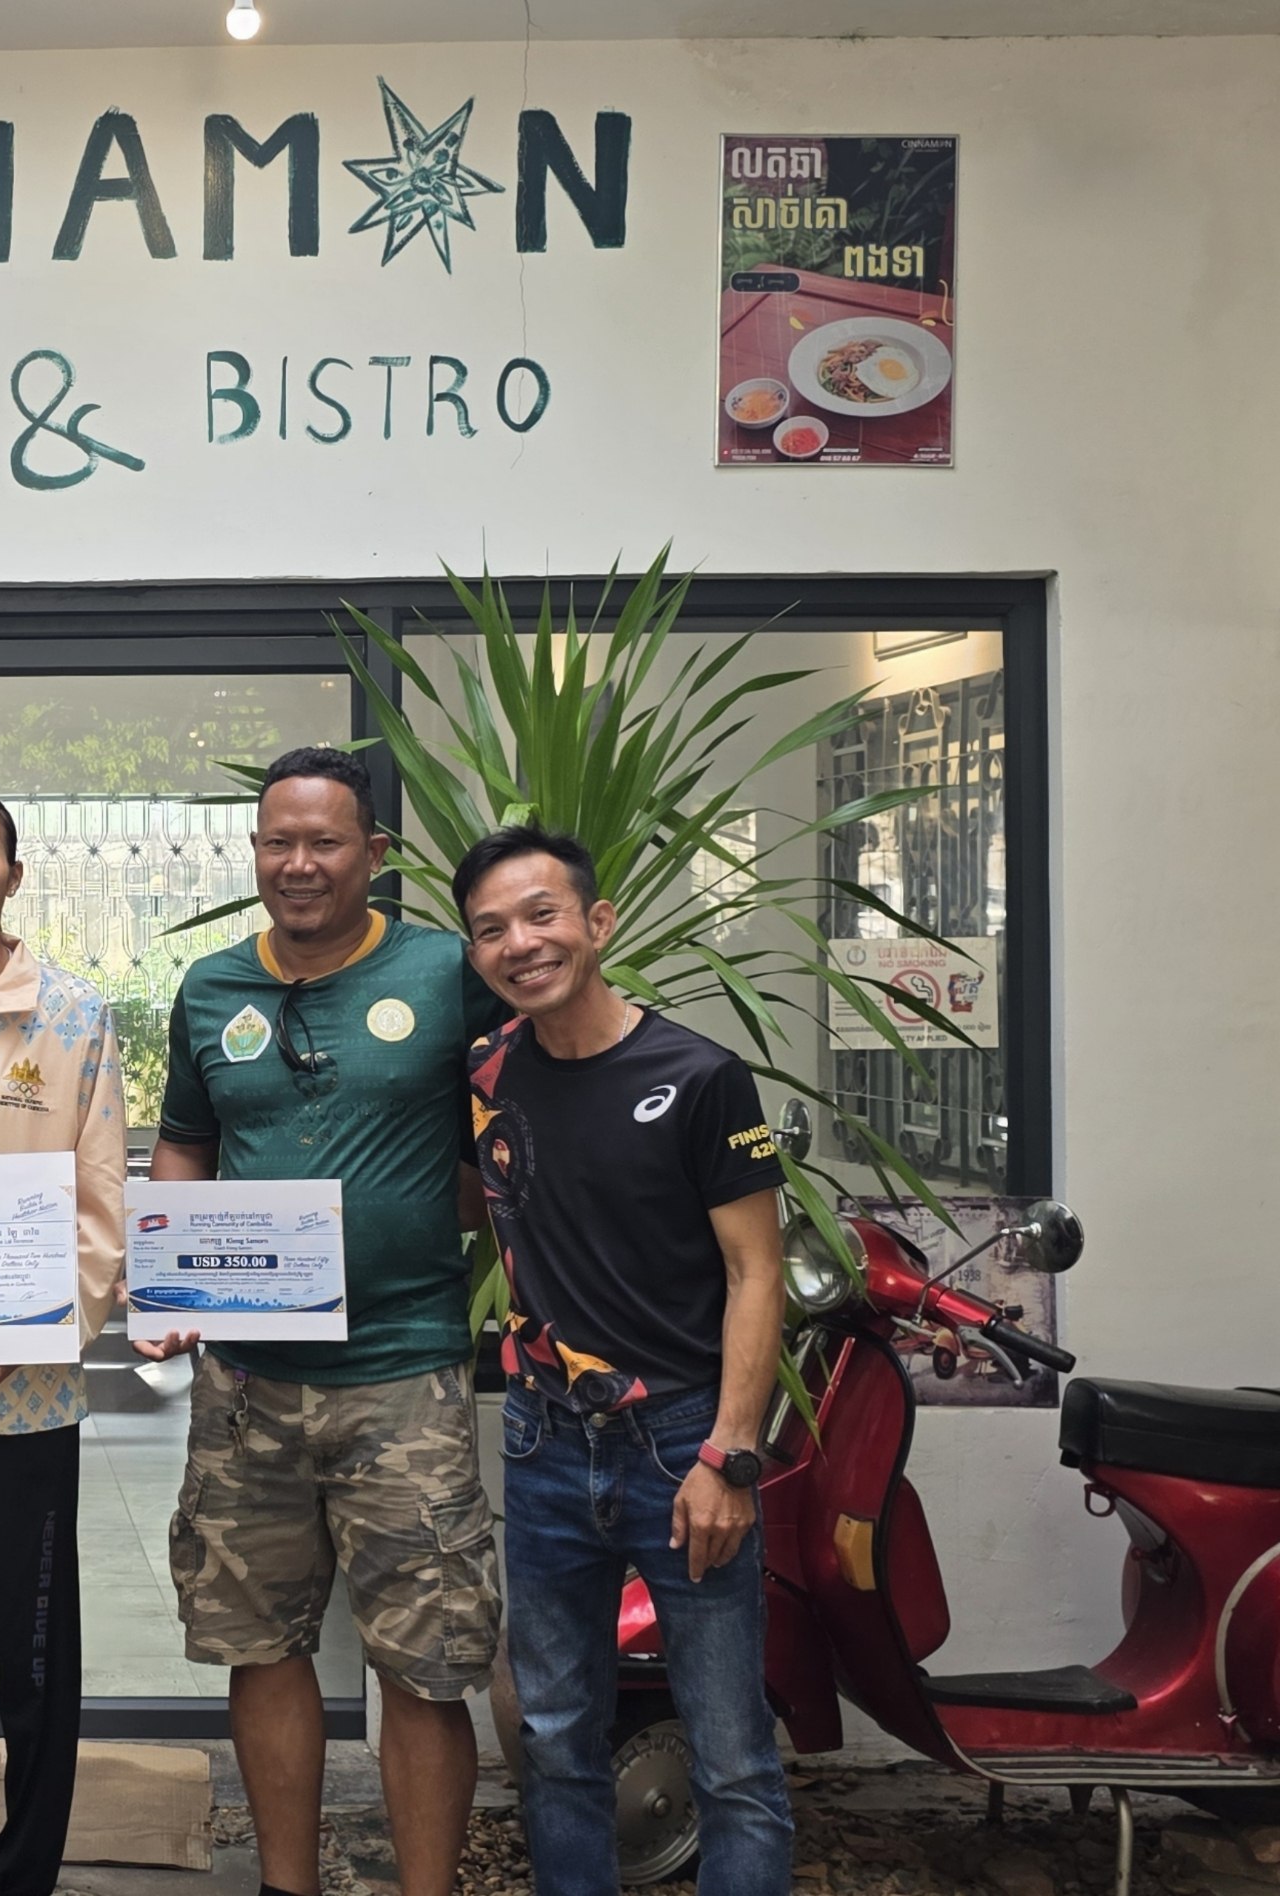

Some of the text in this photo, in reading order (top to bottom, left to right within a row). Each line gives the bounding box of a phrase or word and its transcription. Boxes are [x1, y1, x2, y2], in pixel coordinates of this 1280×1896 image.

[9, 347, 145, 491] &
[207, 349, 552, 446] BISTRO
[879, 960, 946, 968] NO SMOKING
[192, 1256, 267, 1268] USD 350.00
[958, 1270, 982, 1282] 1938
[31, 1510, 56, 1687] NEVER GIVE UP
